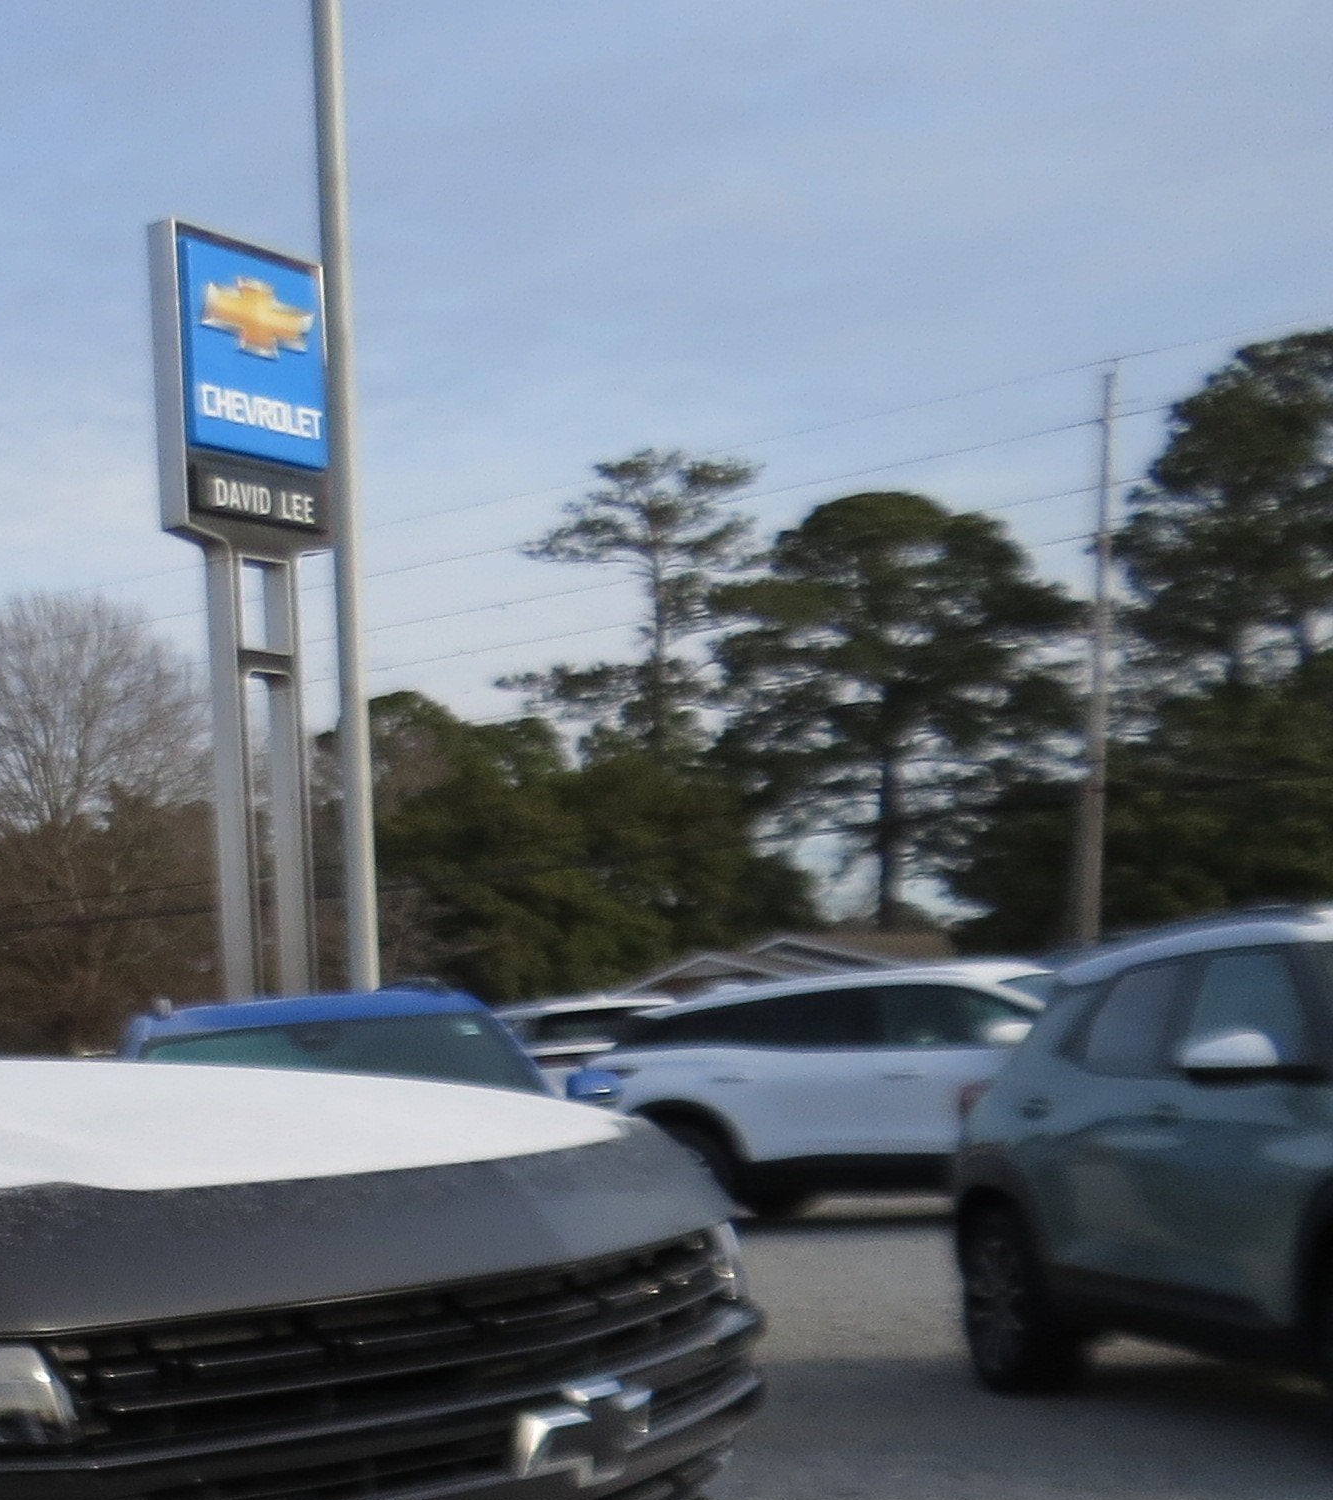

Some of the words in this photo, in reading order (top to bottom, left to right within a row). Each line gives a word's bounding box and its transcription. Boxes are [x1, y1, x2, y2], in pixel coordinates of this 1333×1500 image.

[200, 384, 322, 440] CHEVROLET
[213, 478, 272, 516] DAVID
[282, 491, 316, 525] LEE
